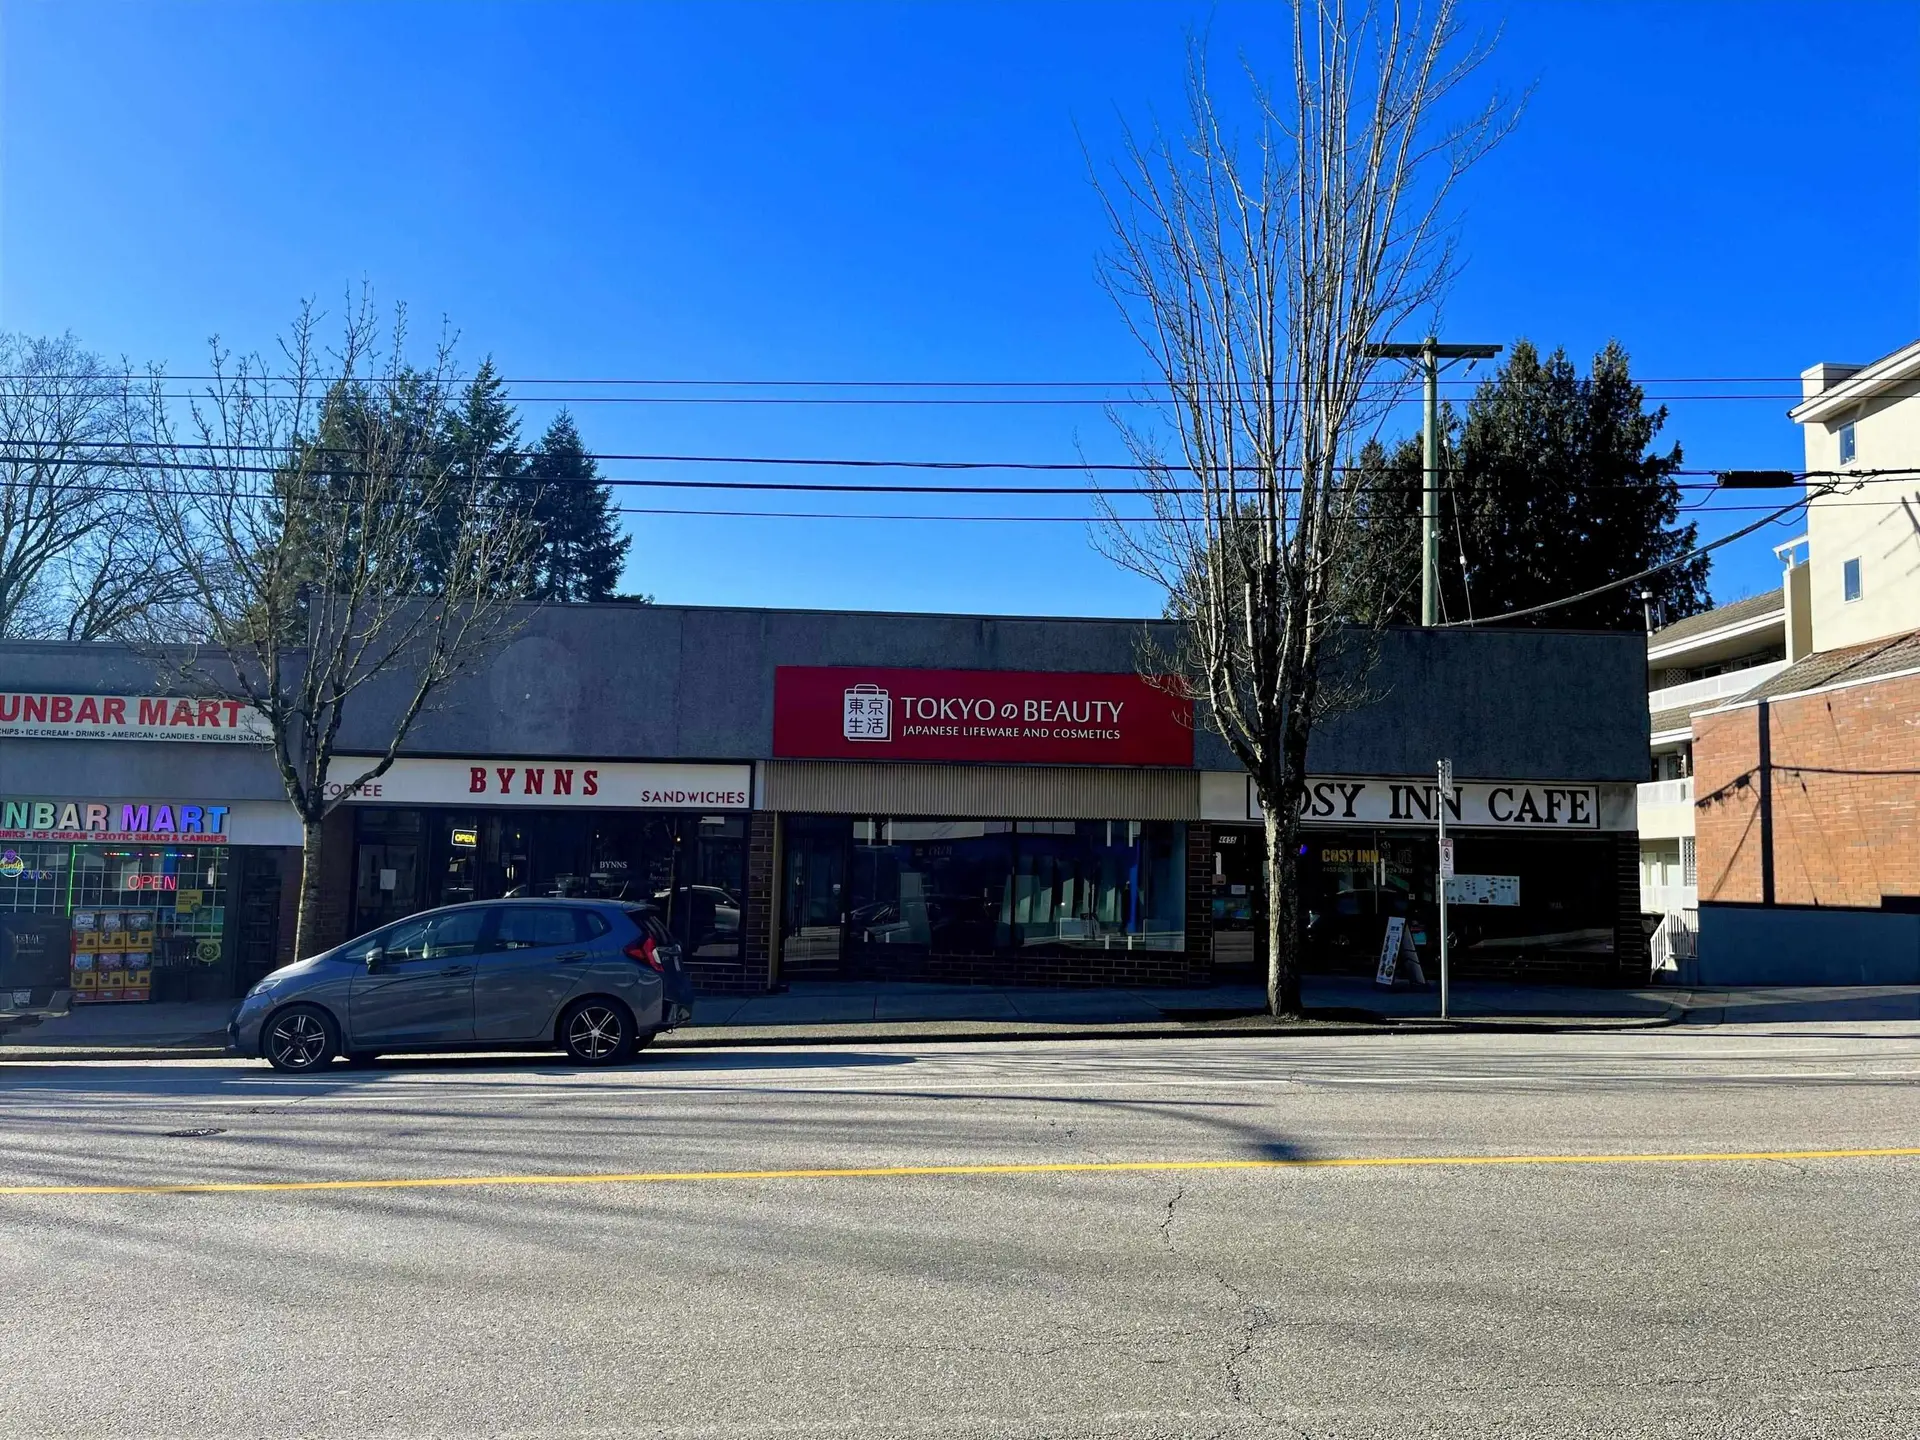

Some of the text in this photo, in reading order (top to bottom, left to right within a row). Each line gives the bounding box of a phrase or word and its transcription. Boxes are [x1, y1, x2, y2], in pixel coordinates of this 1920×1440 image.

[848, 697, 884, 715] 東京
[901, 697, 1124, 723] TOKYO の BEAUTY
[139, 699, 245, 728] MART
[848, 717, 884, 734] 生活
[903, 725, 1120, 739] JAPANESE LIFEWARE AND COSMETICS
[41, 729, 69, 737] CREAM
[76, 730, 105, 738] DRINKS
[112, 731, 154, 739] AMERICAN
[161, 732, 195, 740] CANDIES
[202, 733, 235, 741] ENGLISH
[238, 734, 271, 742] SNACKS
[470, 767, 598, 795] BYNNS
[323, 783, 383, 797] OFEE
[642, 790, 745, 804] SANDWICHES
[1257, 783, 1590, 824] SY INN CAFE
[5, 802, 228, 833] NBAR MART
[33, 831, 49, 840] ICE
[52, 832, 87, 840] CREAM
[95, 832, 132, 841] EXOTIC
[172, 834, 179, 842] &
[182, 834, 227, 843] CANDIES
[454, 834, 476, 843] OPEN
[1218, 836, 1237, 844] 4455
[1322, 849, 1354, 862] COSY
[600, 861, 627, 869] BYNNS
[128, 875, 176, 891] OPEN
